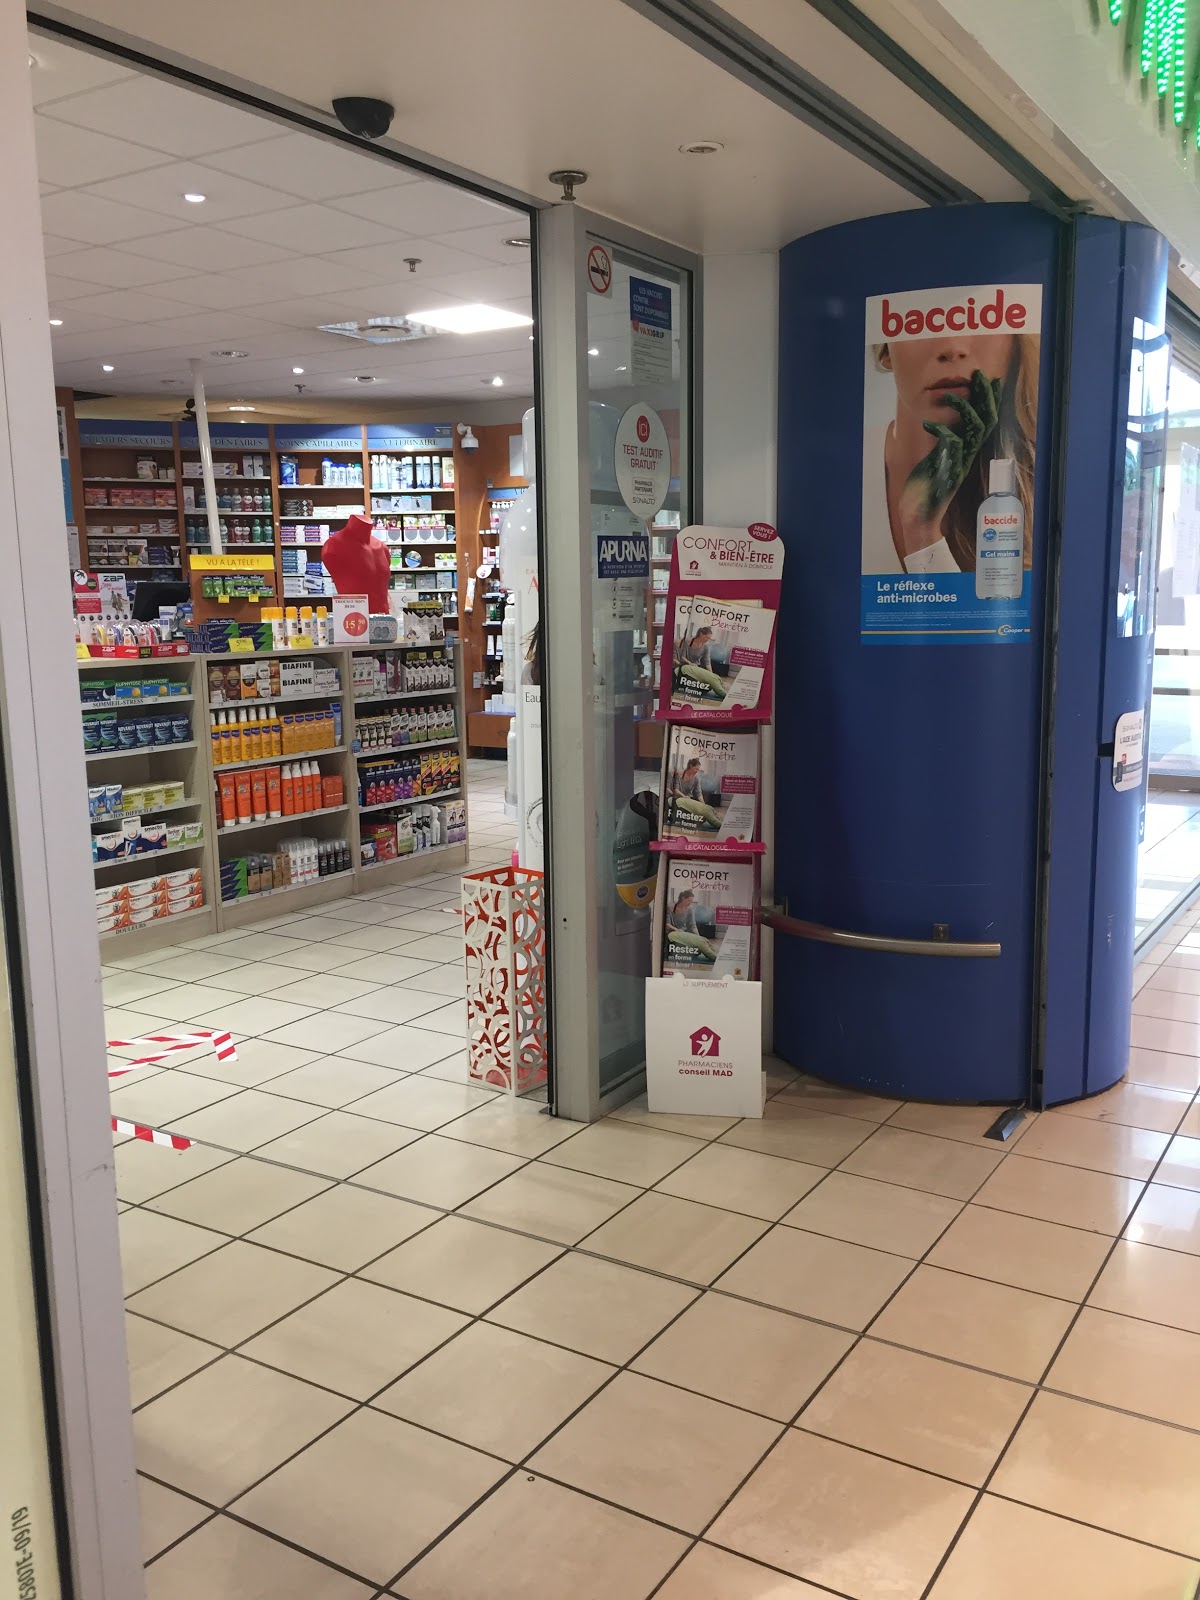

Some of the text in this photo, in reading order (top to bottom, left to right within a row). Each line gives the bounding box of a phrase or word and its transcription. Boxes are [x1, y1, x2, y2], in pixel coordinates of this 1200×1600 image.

[882, 288, 1027, 338] baccide
[639, 326, 665, 339] VAXIGRIP
[83, 435, 171, 447] PREMIERS SECOURS
[214, 438, 263, 447] DENTAIRES
[279, 439, 359, 448] SOINS CAPILLAIRES
[623, 444, 663, 460] TEST AUDITIF
[984, 514, 1018, 525] baccide
[752, 530, 768, 539] VOUS
[753, 525, 774, 535] SERVEZ
[683, 536, 754, 553] CONFORT
[599, 540, 648, 563] APURNA
[709, 550, 775, 564] & BIEN-ÊTRE
[205, 558, 218, 566] VU
[227, 558, 236, 566] LA
[718, 561, 743, 569] MAINTIEN
[877, 580, 935, 592] Le réflexe
[877, 592, 957, 604] anti-microbes
[695, 604, 750, 623] CONFORT
[345, 620, 356, 629] 15
[282, 661, 312, 670] BIAFINE
[115, 680, 141, 688] EUPHYTOSE
[143, 678, 168, 686] EUPHYTOSE
[282, 677, 313, 686] BIAFINE
[680, 677, 710, 691] Restez
[685, 687, 702, 696] forme
[92, 698, 144, 709] SOMMEIL-STRESS
[684, 736, 736, 752] CONFORT
[125, 807, 153, 817] DIFFICILE
[675, 809, 704, 822] Restez
[681, 820, 698, 828] forme
[673, 868, 730, 881] CONFORT
[115, 922, 147, 935] DOULEURS
[668, 944, 699, 955] Restez
[677, 1060, 734, 1069] PHARMACIENS
[678, 1068, 710, 1076] conseil
